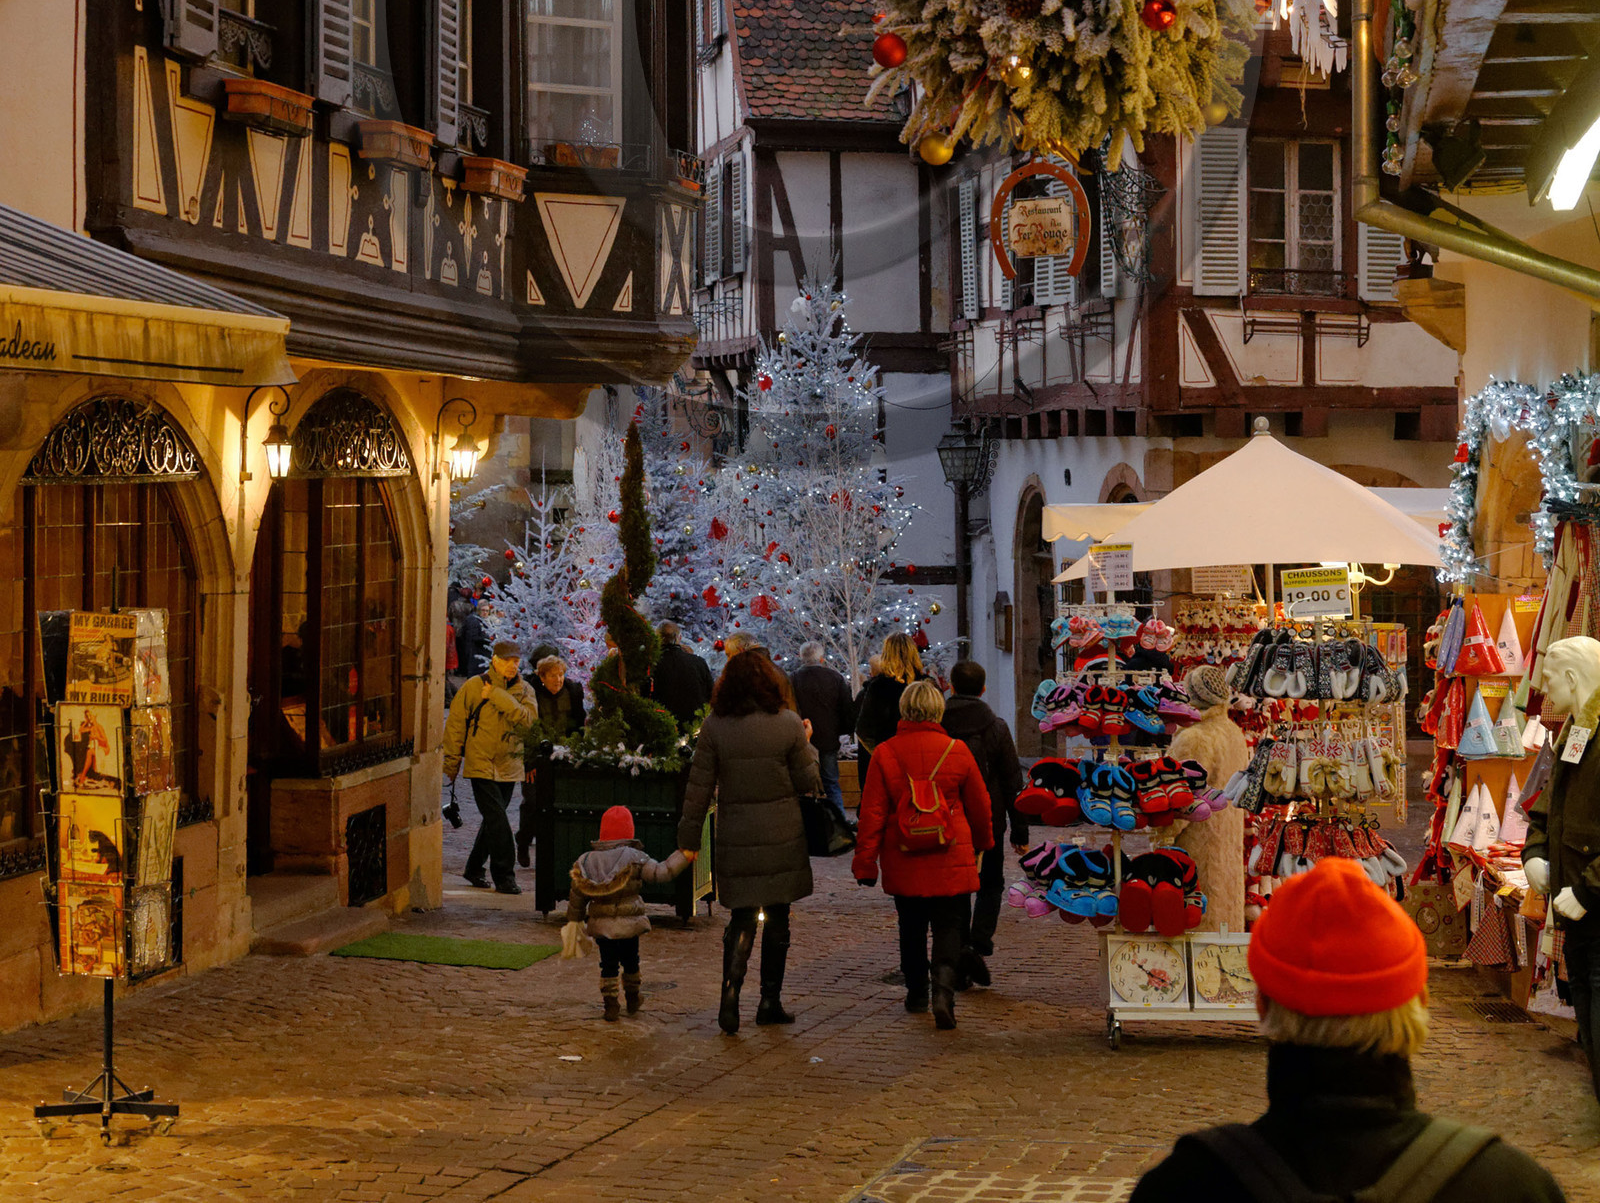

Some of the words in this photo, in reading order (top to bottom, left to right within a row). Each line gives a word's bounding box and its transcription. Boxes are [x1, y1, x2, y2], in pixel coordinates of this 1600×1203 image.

[1018, 203, 1062, 217] Restaurant
[1013, 223, 1032, 245] Fer
[1031, 222, 1068, 245] Rouge
[1287, 569, 1342, 579] CHAUSSONS
[1287, 590, 1331, 604] 19.00
[1335, 589, 1346, 600] €
[74, 614, 91, 627] MY
[92, 615, 135, 630] GARAGE
